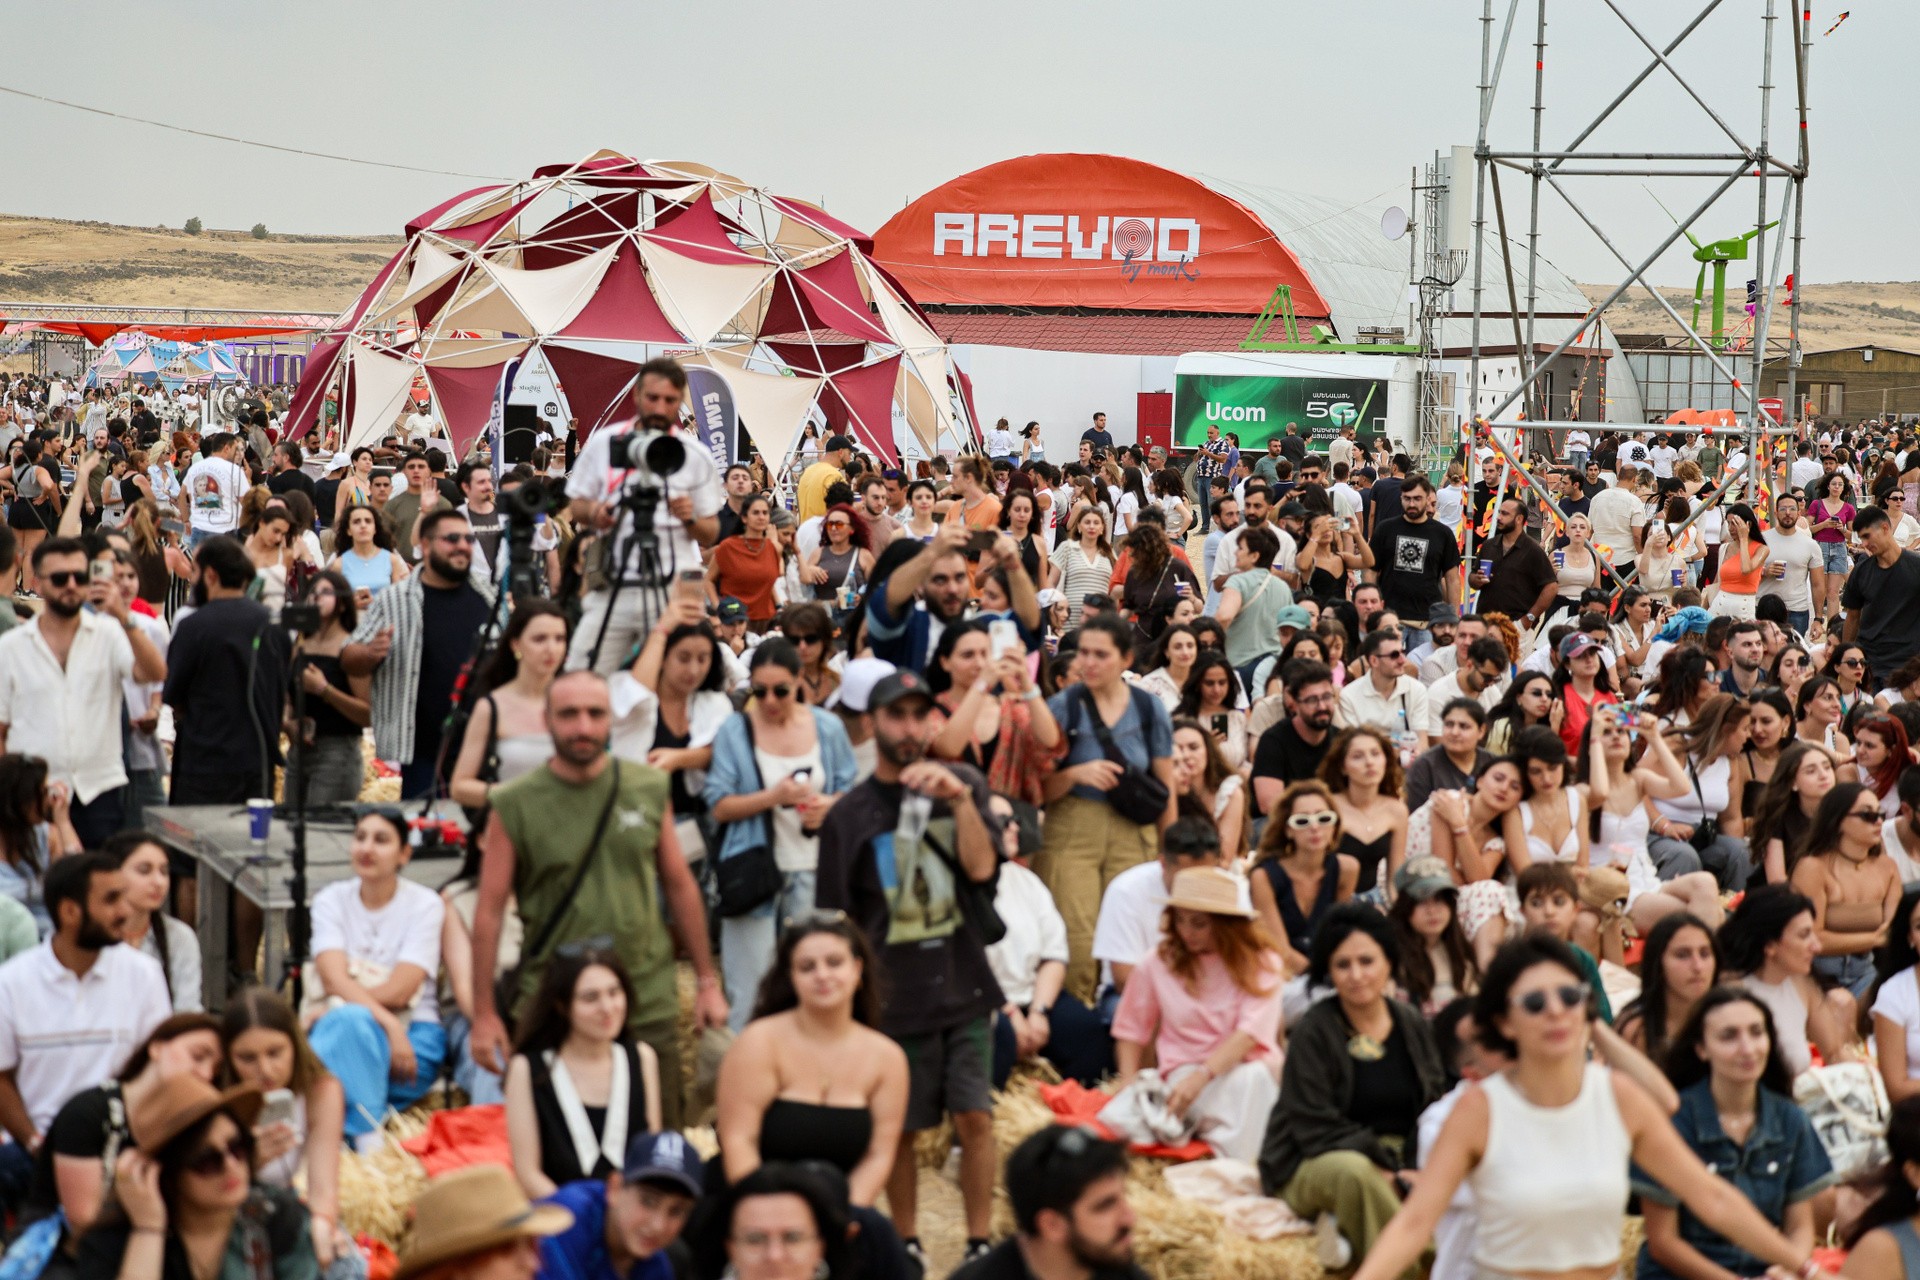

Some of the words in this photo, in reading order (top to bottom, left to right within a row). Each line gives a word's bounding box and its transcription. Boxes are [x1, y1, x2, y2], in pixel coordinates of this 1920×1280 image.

[1121, 249, 1142, 283] by
[1206, 402, 1266, 421] Ucom
[1306, 401, 1355, 418] 5G
